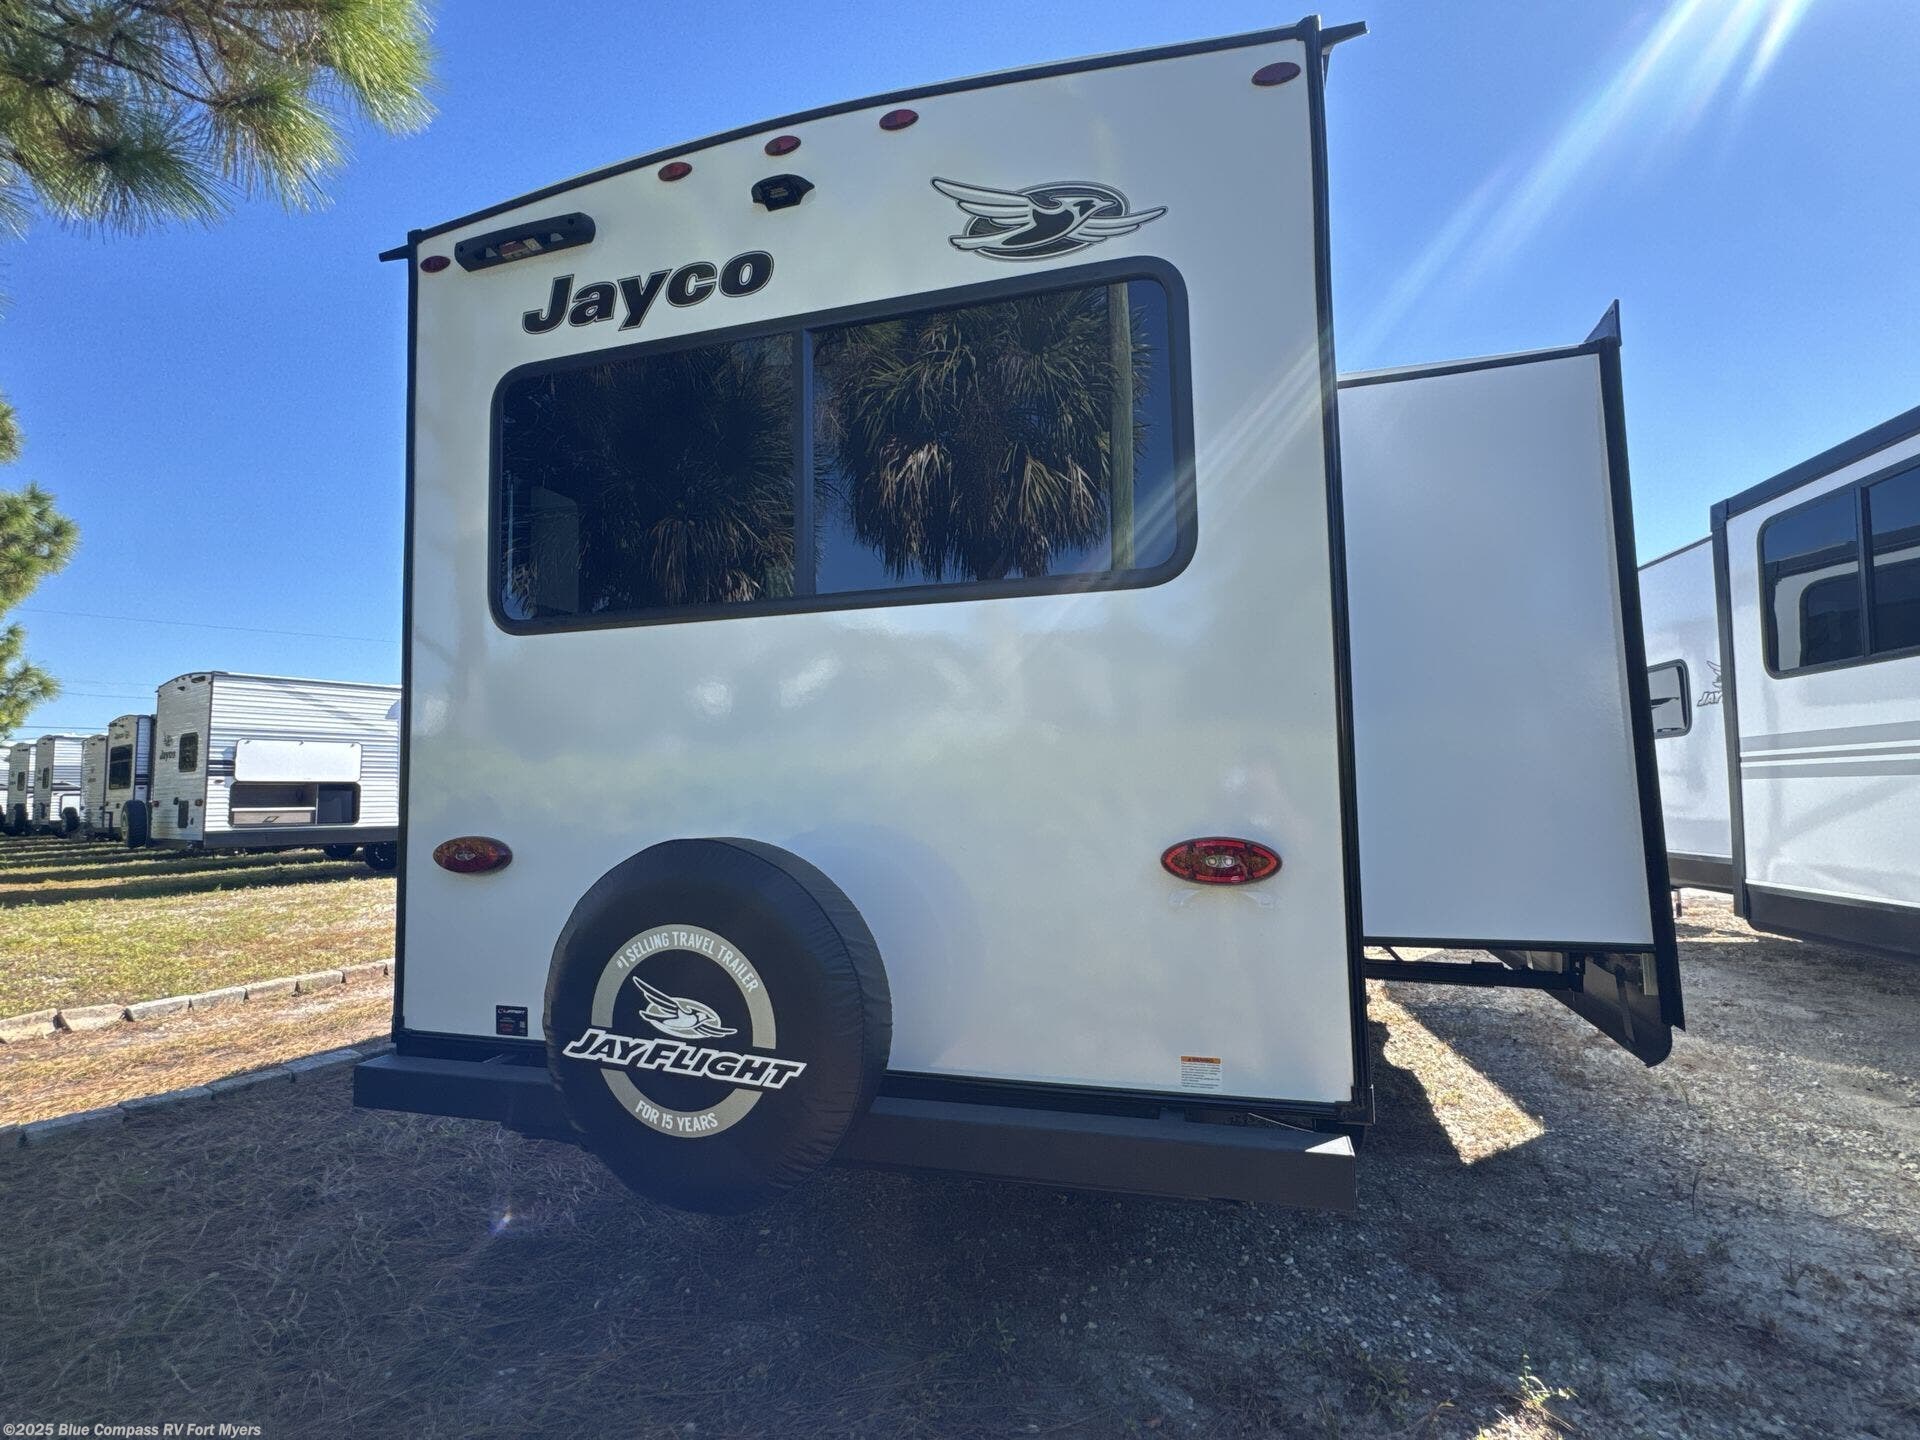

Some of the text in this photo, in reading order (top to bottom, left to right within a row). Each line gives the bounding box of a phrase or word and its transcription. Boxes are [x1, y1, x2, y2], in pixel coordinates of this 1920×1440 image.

[522, 250, 774, 334] Jayco
[616, 931, 759, 993] #1 SELLING TRAVEL TRAILER
[635, 1100, 719, 1132] FOR 15 YEARS
